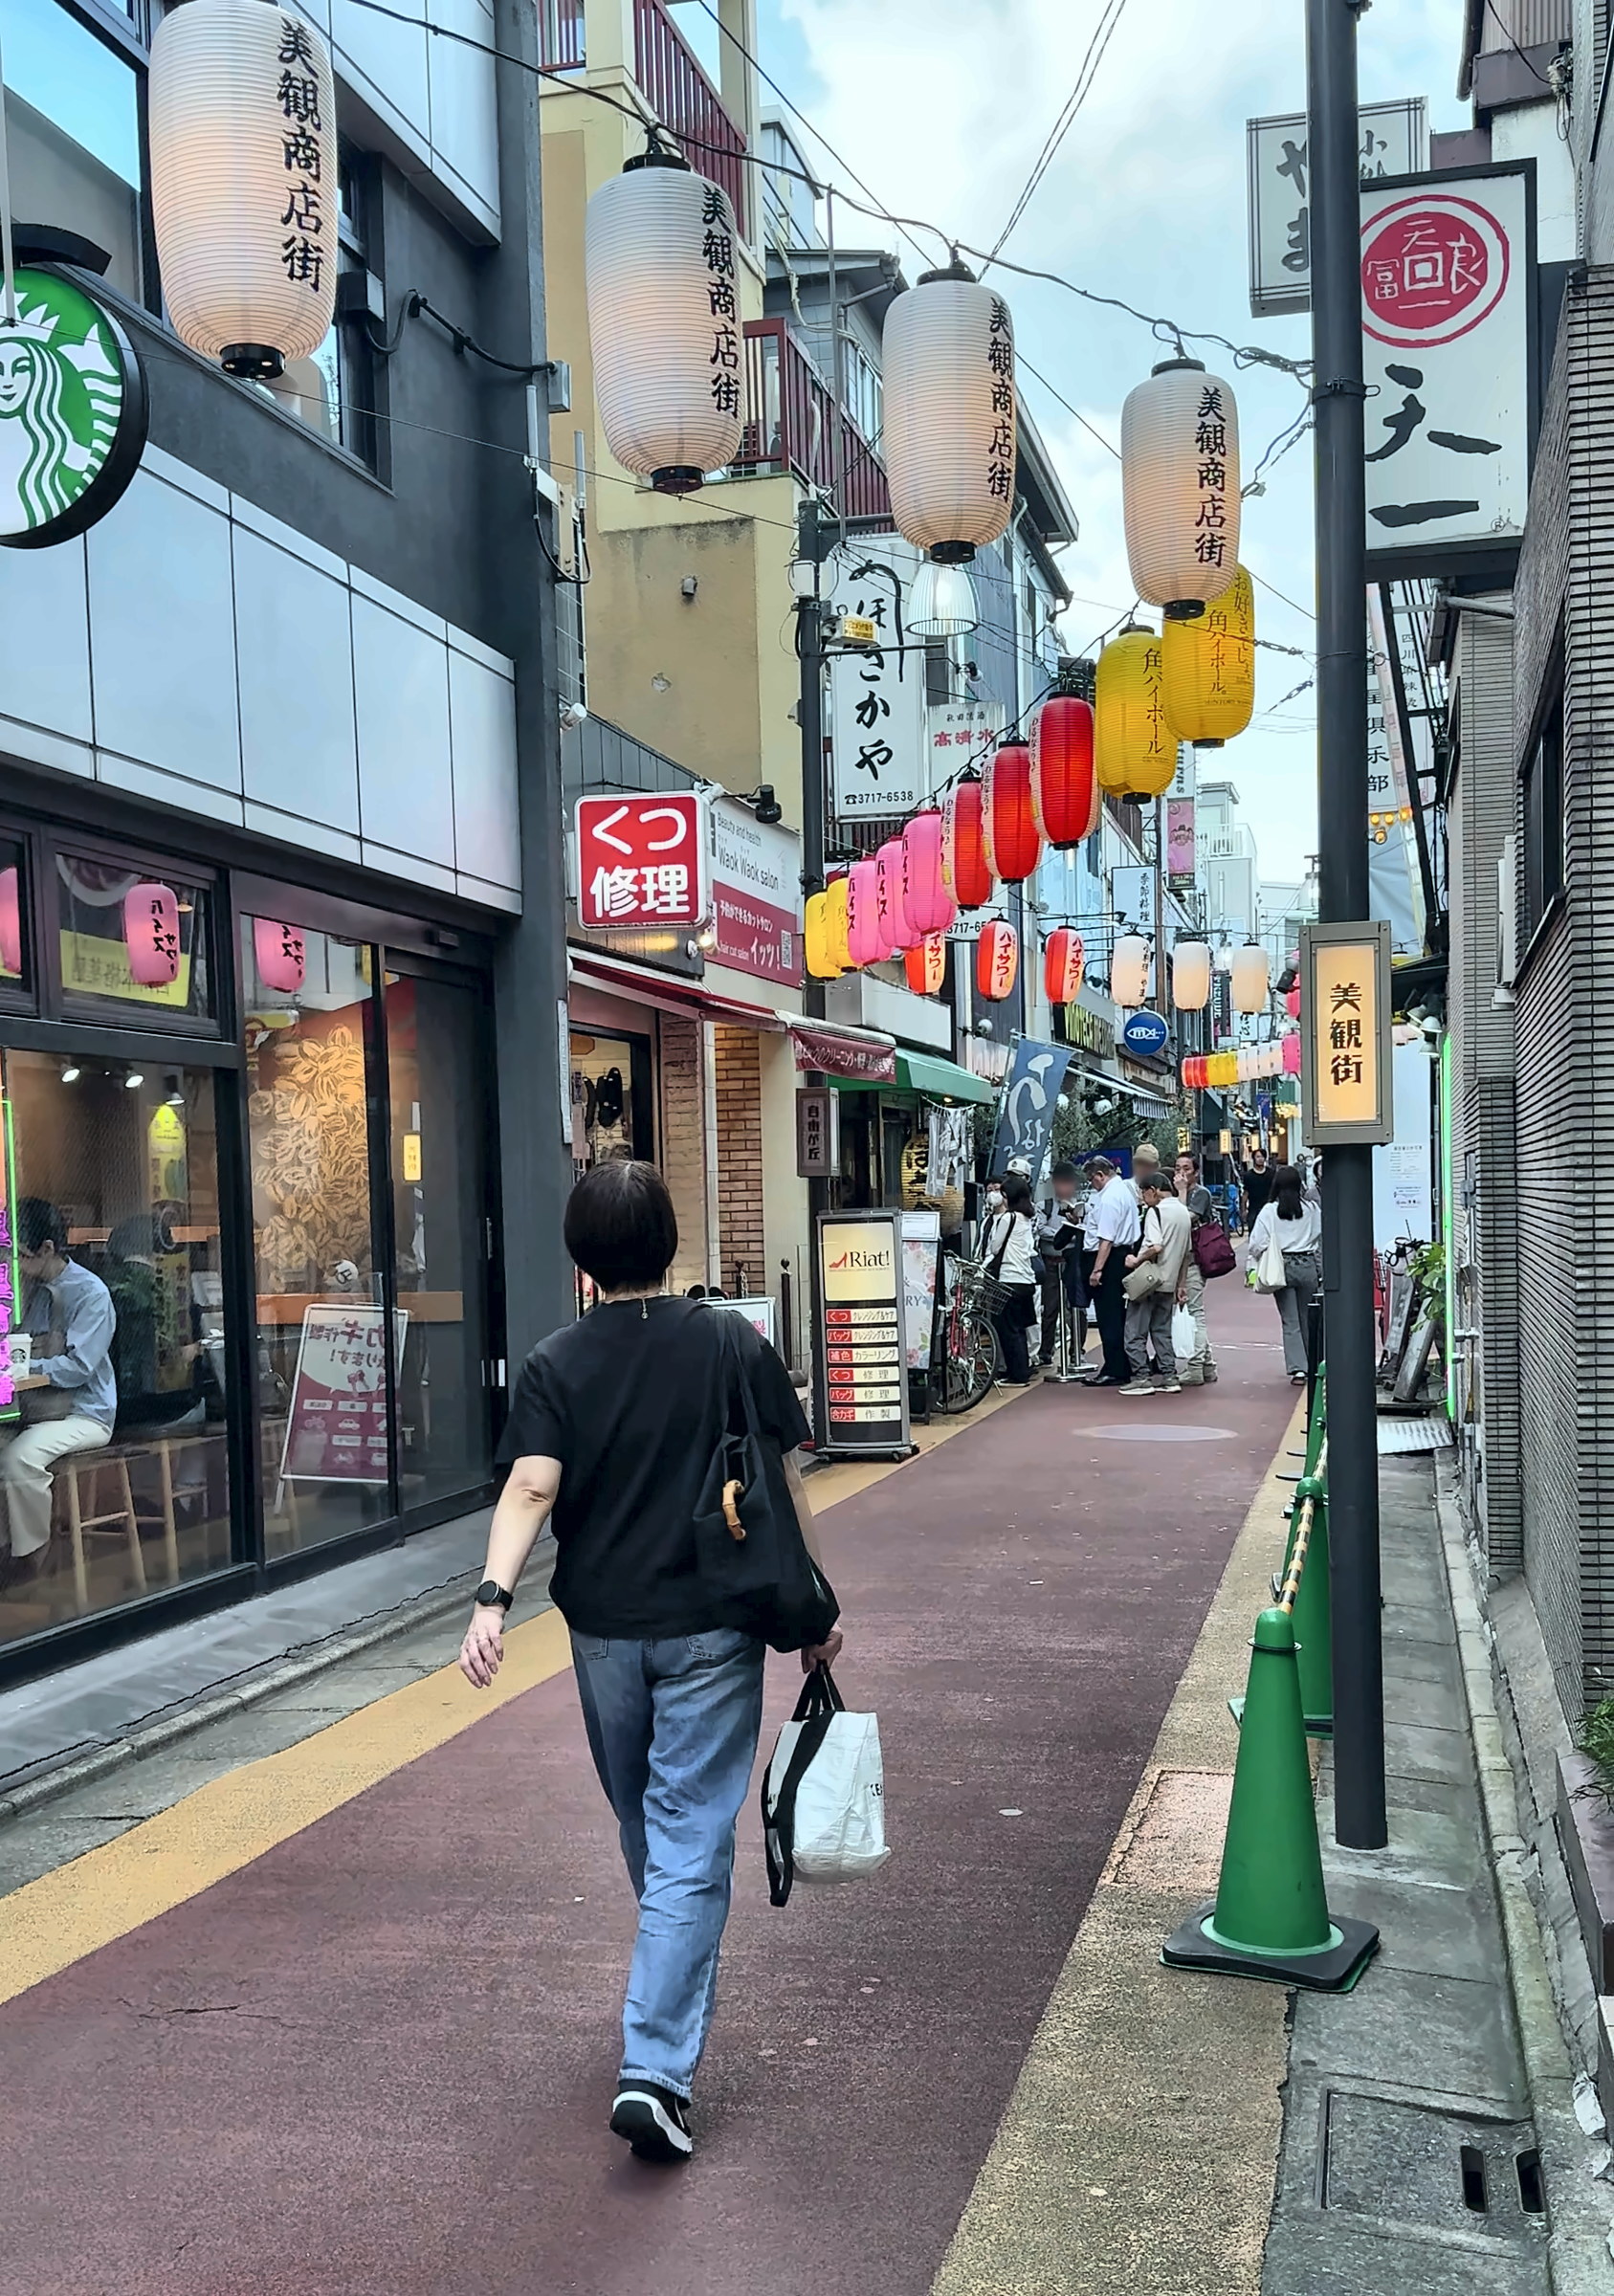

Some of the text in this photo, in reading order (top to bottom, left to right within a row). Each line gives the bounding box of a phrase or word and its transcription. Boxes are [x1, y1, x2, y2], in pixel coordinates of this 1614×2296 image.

[276, 16, 324, 292] 美観商店街
[700, 188, 741, 419] 美観商店街
[986, 297, 1014, 502] 美観商店街
[1195, 386, 1226, 568] 美観商店街
[1143, 649, 1164, 755] 角ハイボール
[858, 790, 914, 805] 3717-6538
[591, 806, 687, 855] くつ
[589, 864, 690, 918] 修理
[997, 931, 1012, 987] ハイサワー
[1069, 938, 1082, 989] ハイサワー
[1330, 982, 1362, 1085] 美観街
[808, 1105, 820, 1160] 自由が丘
[850, 1250, 890, 1268] Riat!
[829, 1311, 850, 1322] くつ
[831, 1369, 889, 1380] くつ 修理
[854, 1349, 896, 1361] カラーリング
[864, 1389, 890, 1400] 修理
[865, 1408, 891, 1419] 作製
